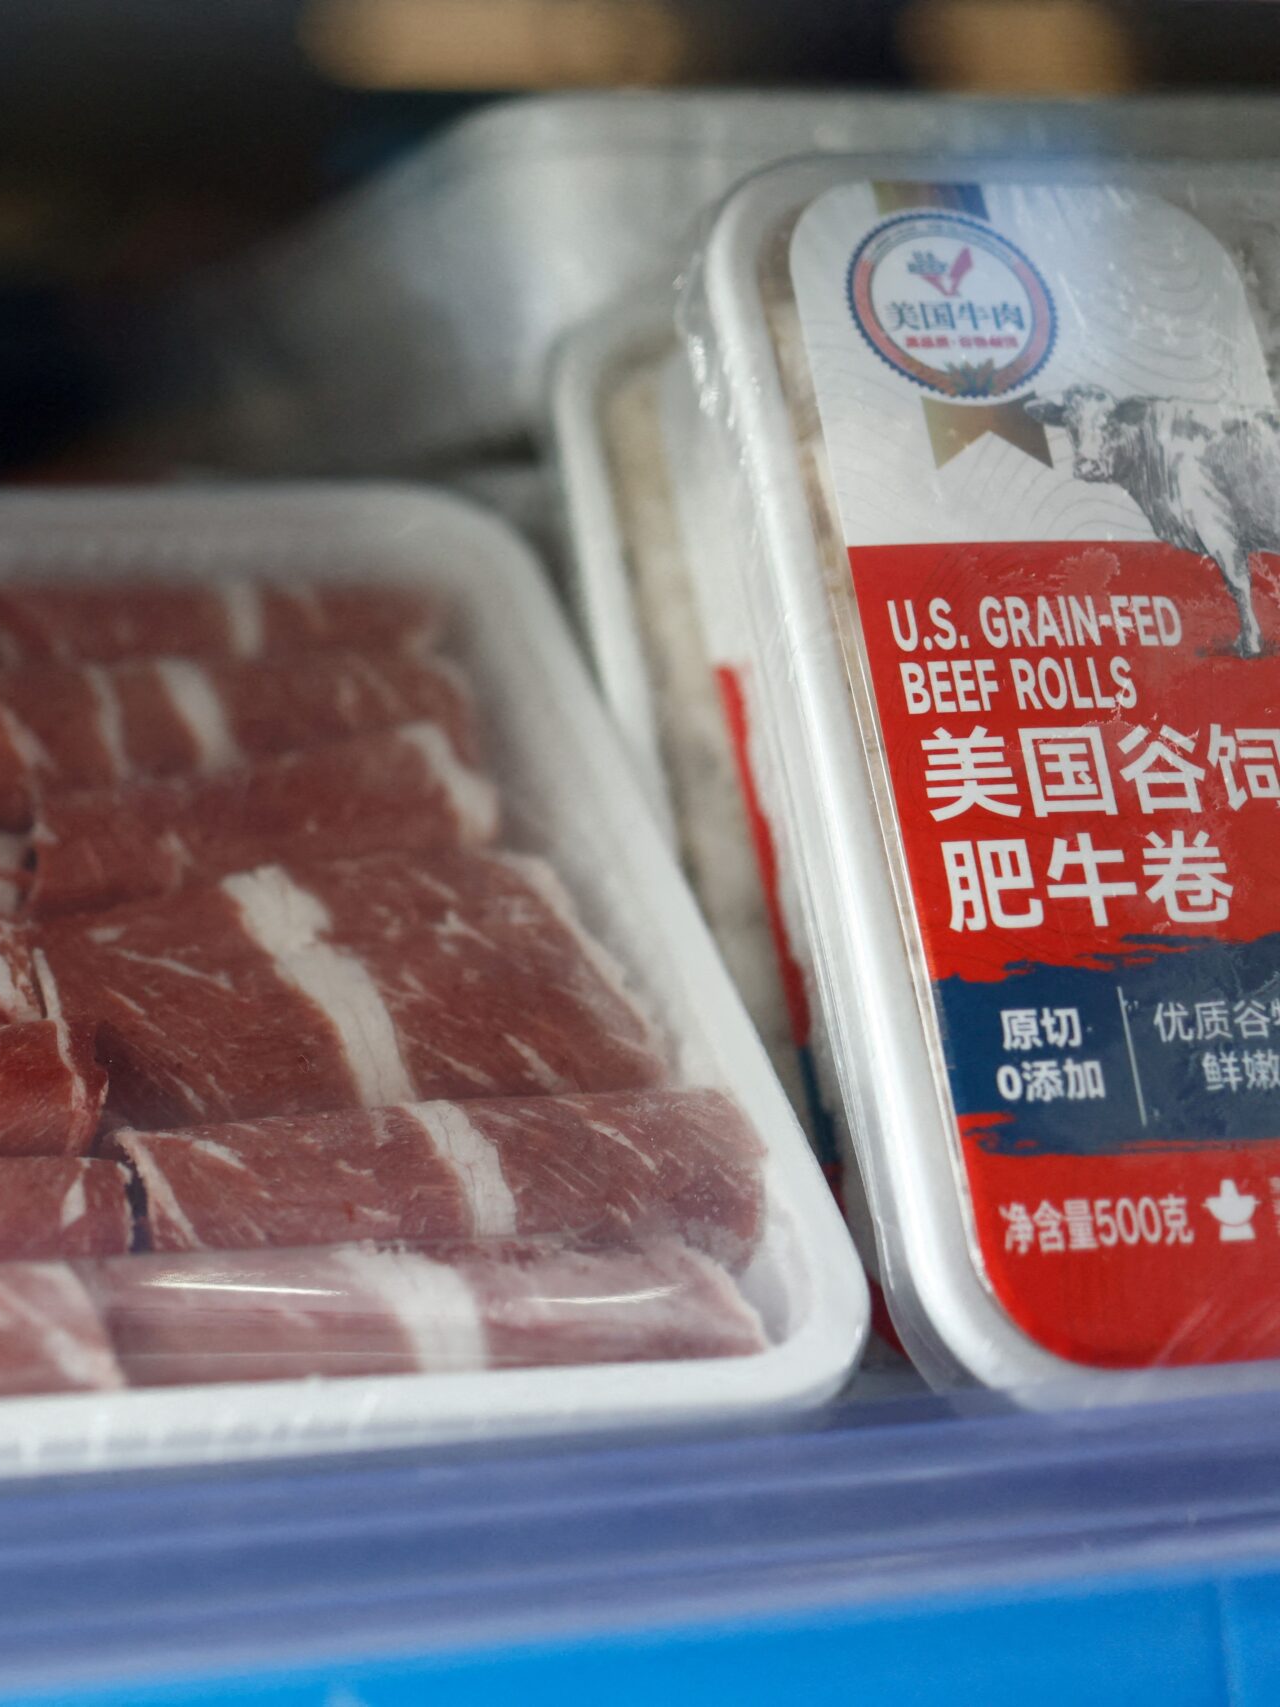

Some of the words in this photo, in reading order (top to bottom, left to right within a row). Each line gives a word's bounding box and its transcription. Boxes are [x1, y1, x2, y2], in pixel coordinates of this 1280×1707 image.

[887, 301, 1026, 331] 美国牛肉
[887, 597, 970, 652] U.S.
[979, 595, 1183, 650] GRAIN-FED
[899, 658, 1001, 715] BEEF
[1009, 656, 1139, 711] ROLLS
[921, 723, 1280, 823] 美国谷饲
[940, 829, 1235, 933] 肥牛卷
[1000, 1006, 1083, 1051] 原切
[996, 1058, 1106, 1102] 0添加
[998, 1193, 1195, 1255] 净含量500克
